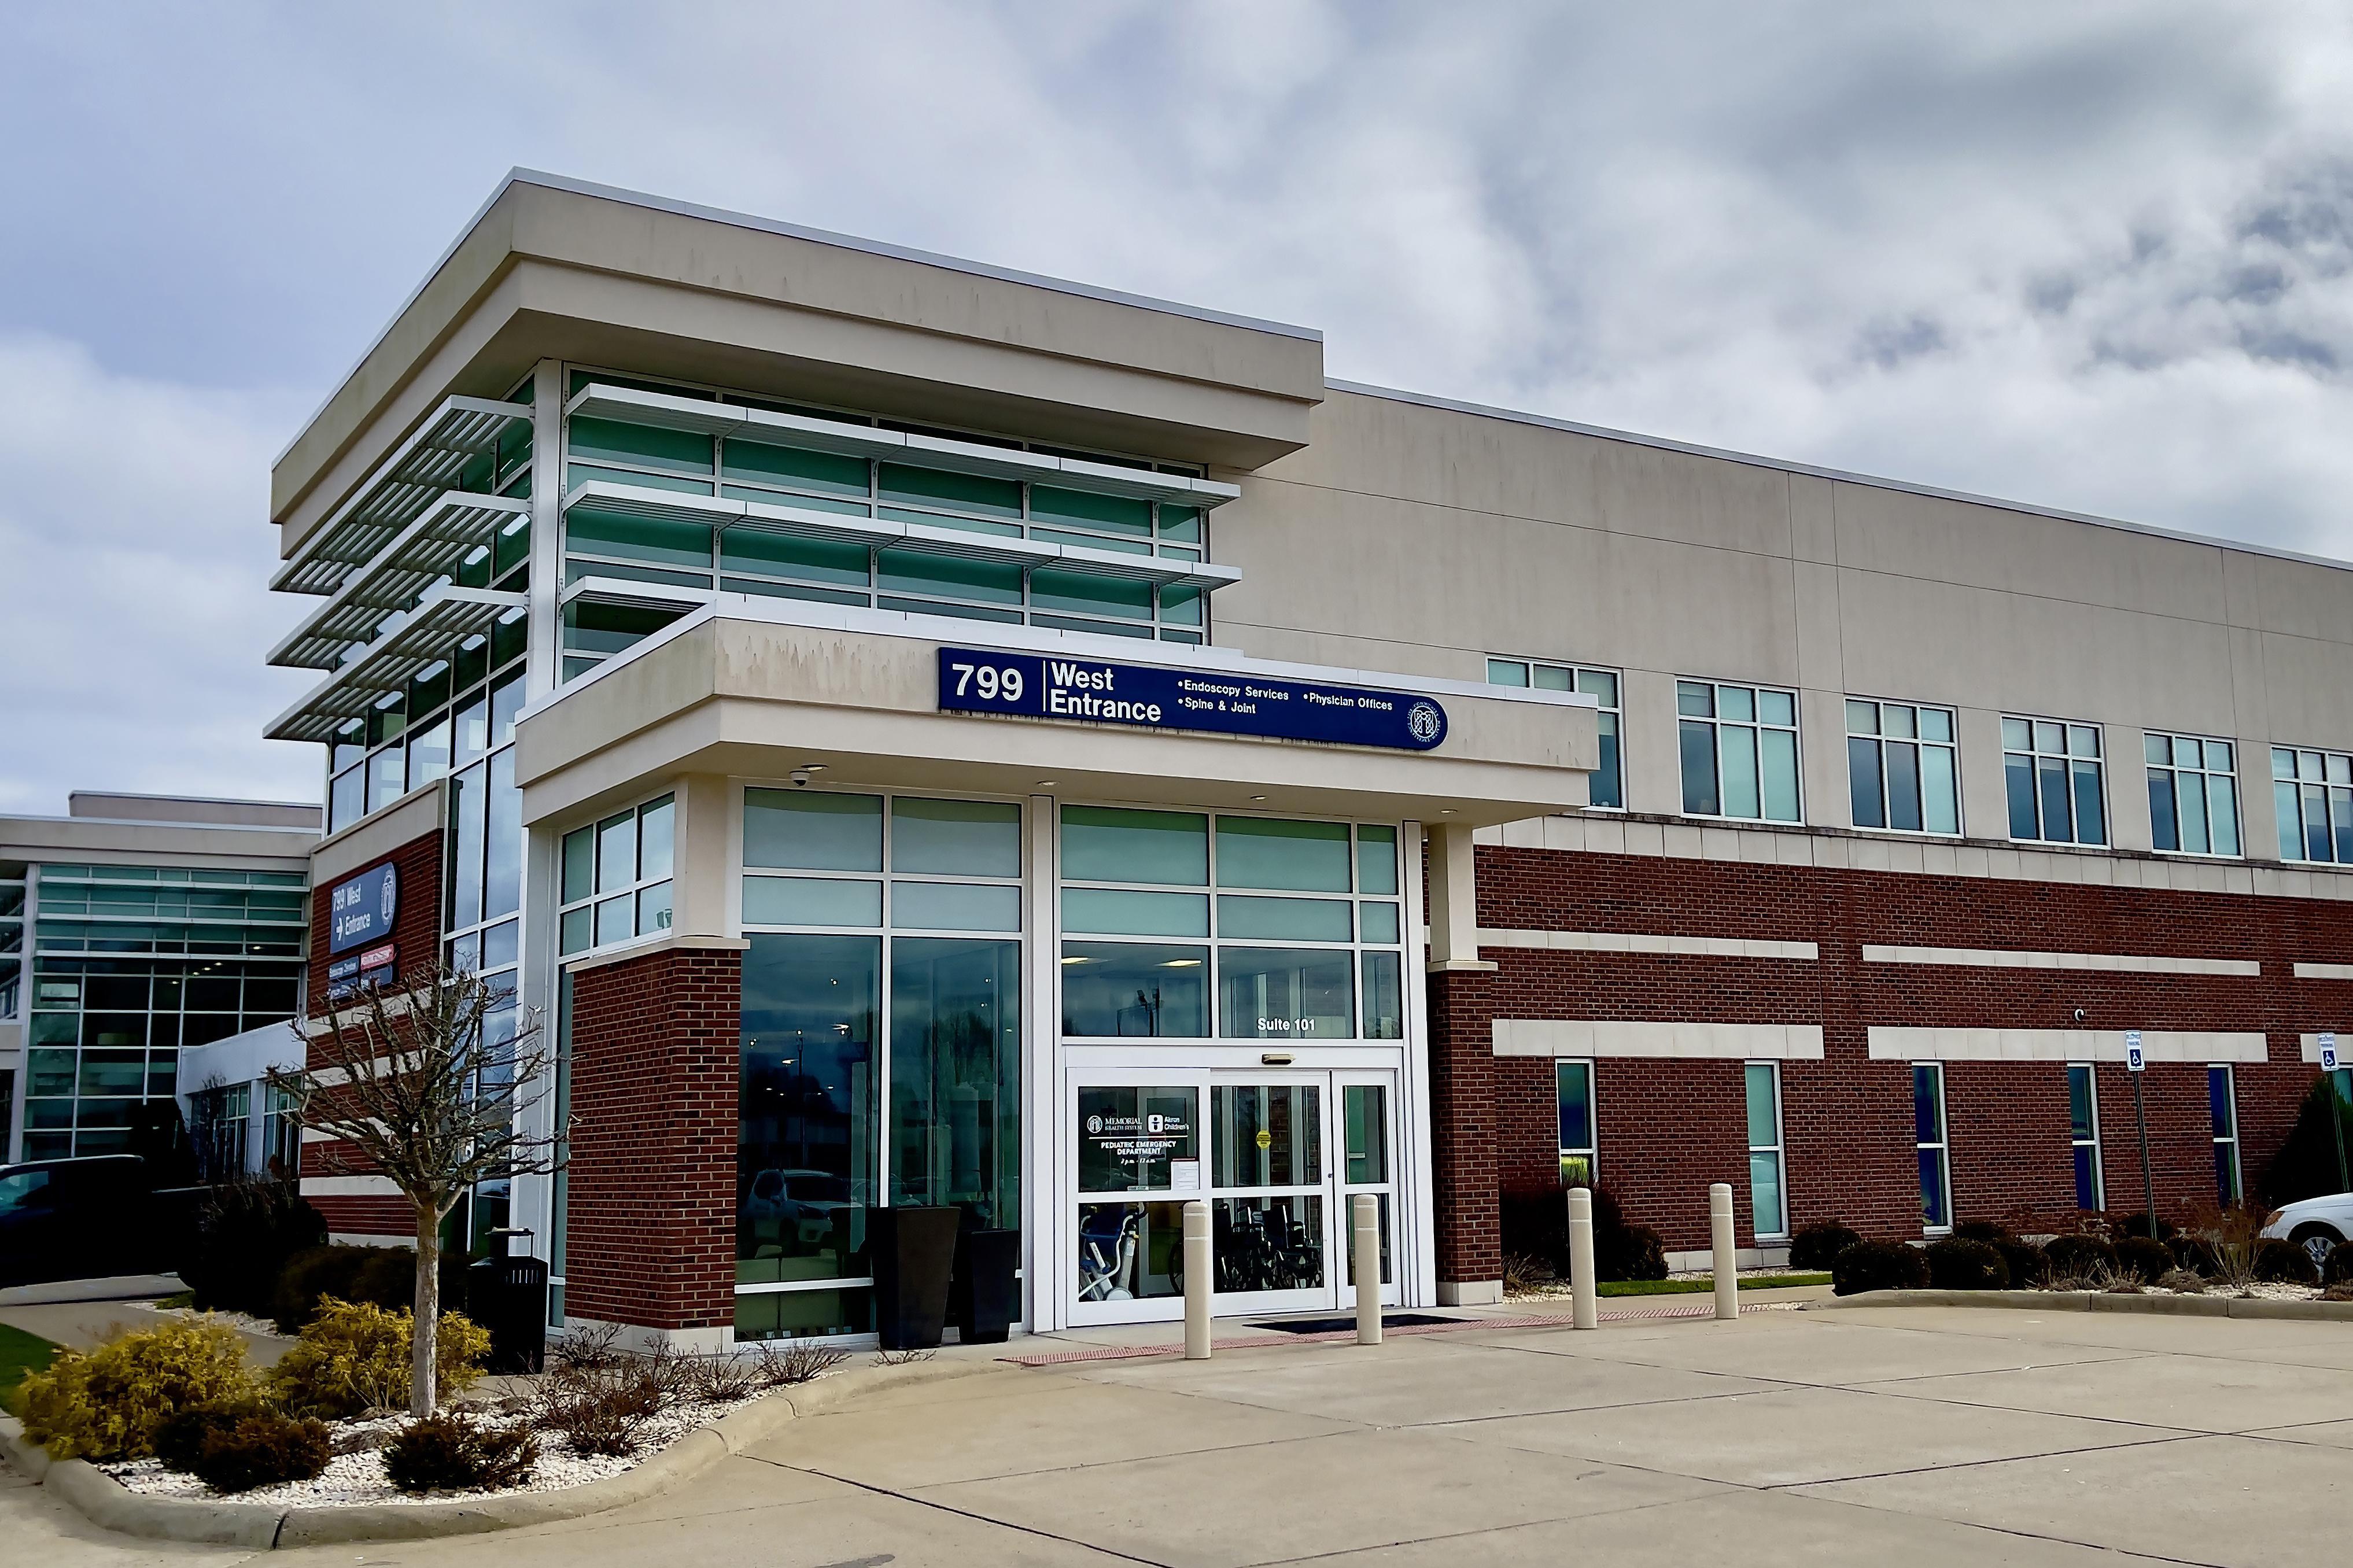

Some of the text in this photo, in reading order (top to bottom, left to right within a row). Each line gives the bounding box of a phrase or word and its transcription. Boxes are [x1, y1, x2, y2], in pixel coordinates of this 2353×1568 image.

[952, 663, 1023, 701] 799
[1051, 662, 1114, 691] West
[1184, 680, 1289, 700] Endoscopy Services
[1050, 689, 1161, 722] Entrance
[1185, 697, 1256, 714] Spine & Joint
[1310, 693, 1392, 711] Physician Offices
[333, 883, 361, 912] 799 West
[345, 913, 370, 935] Entrance
[1257, 1018, 1315, 1031] Suite 101
[1105, 1117, 1142, 1125] MEMORIAL
